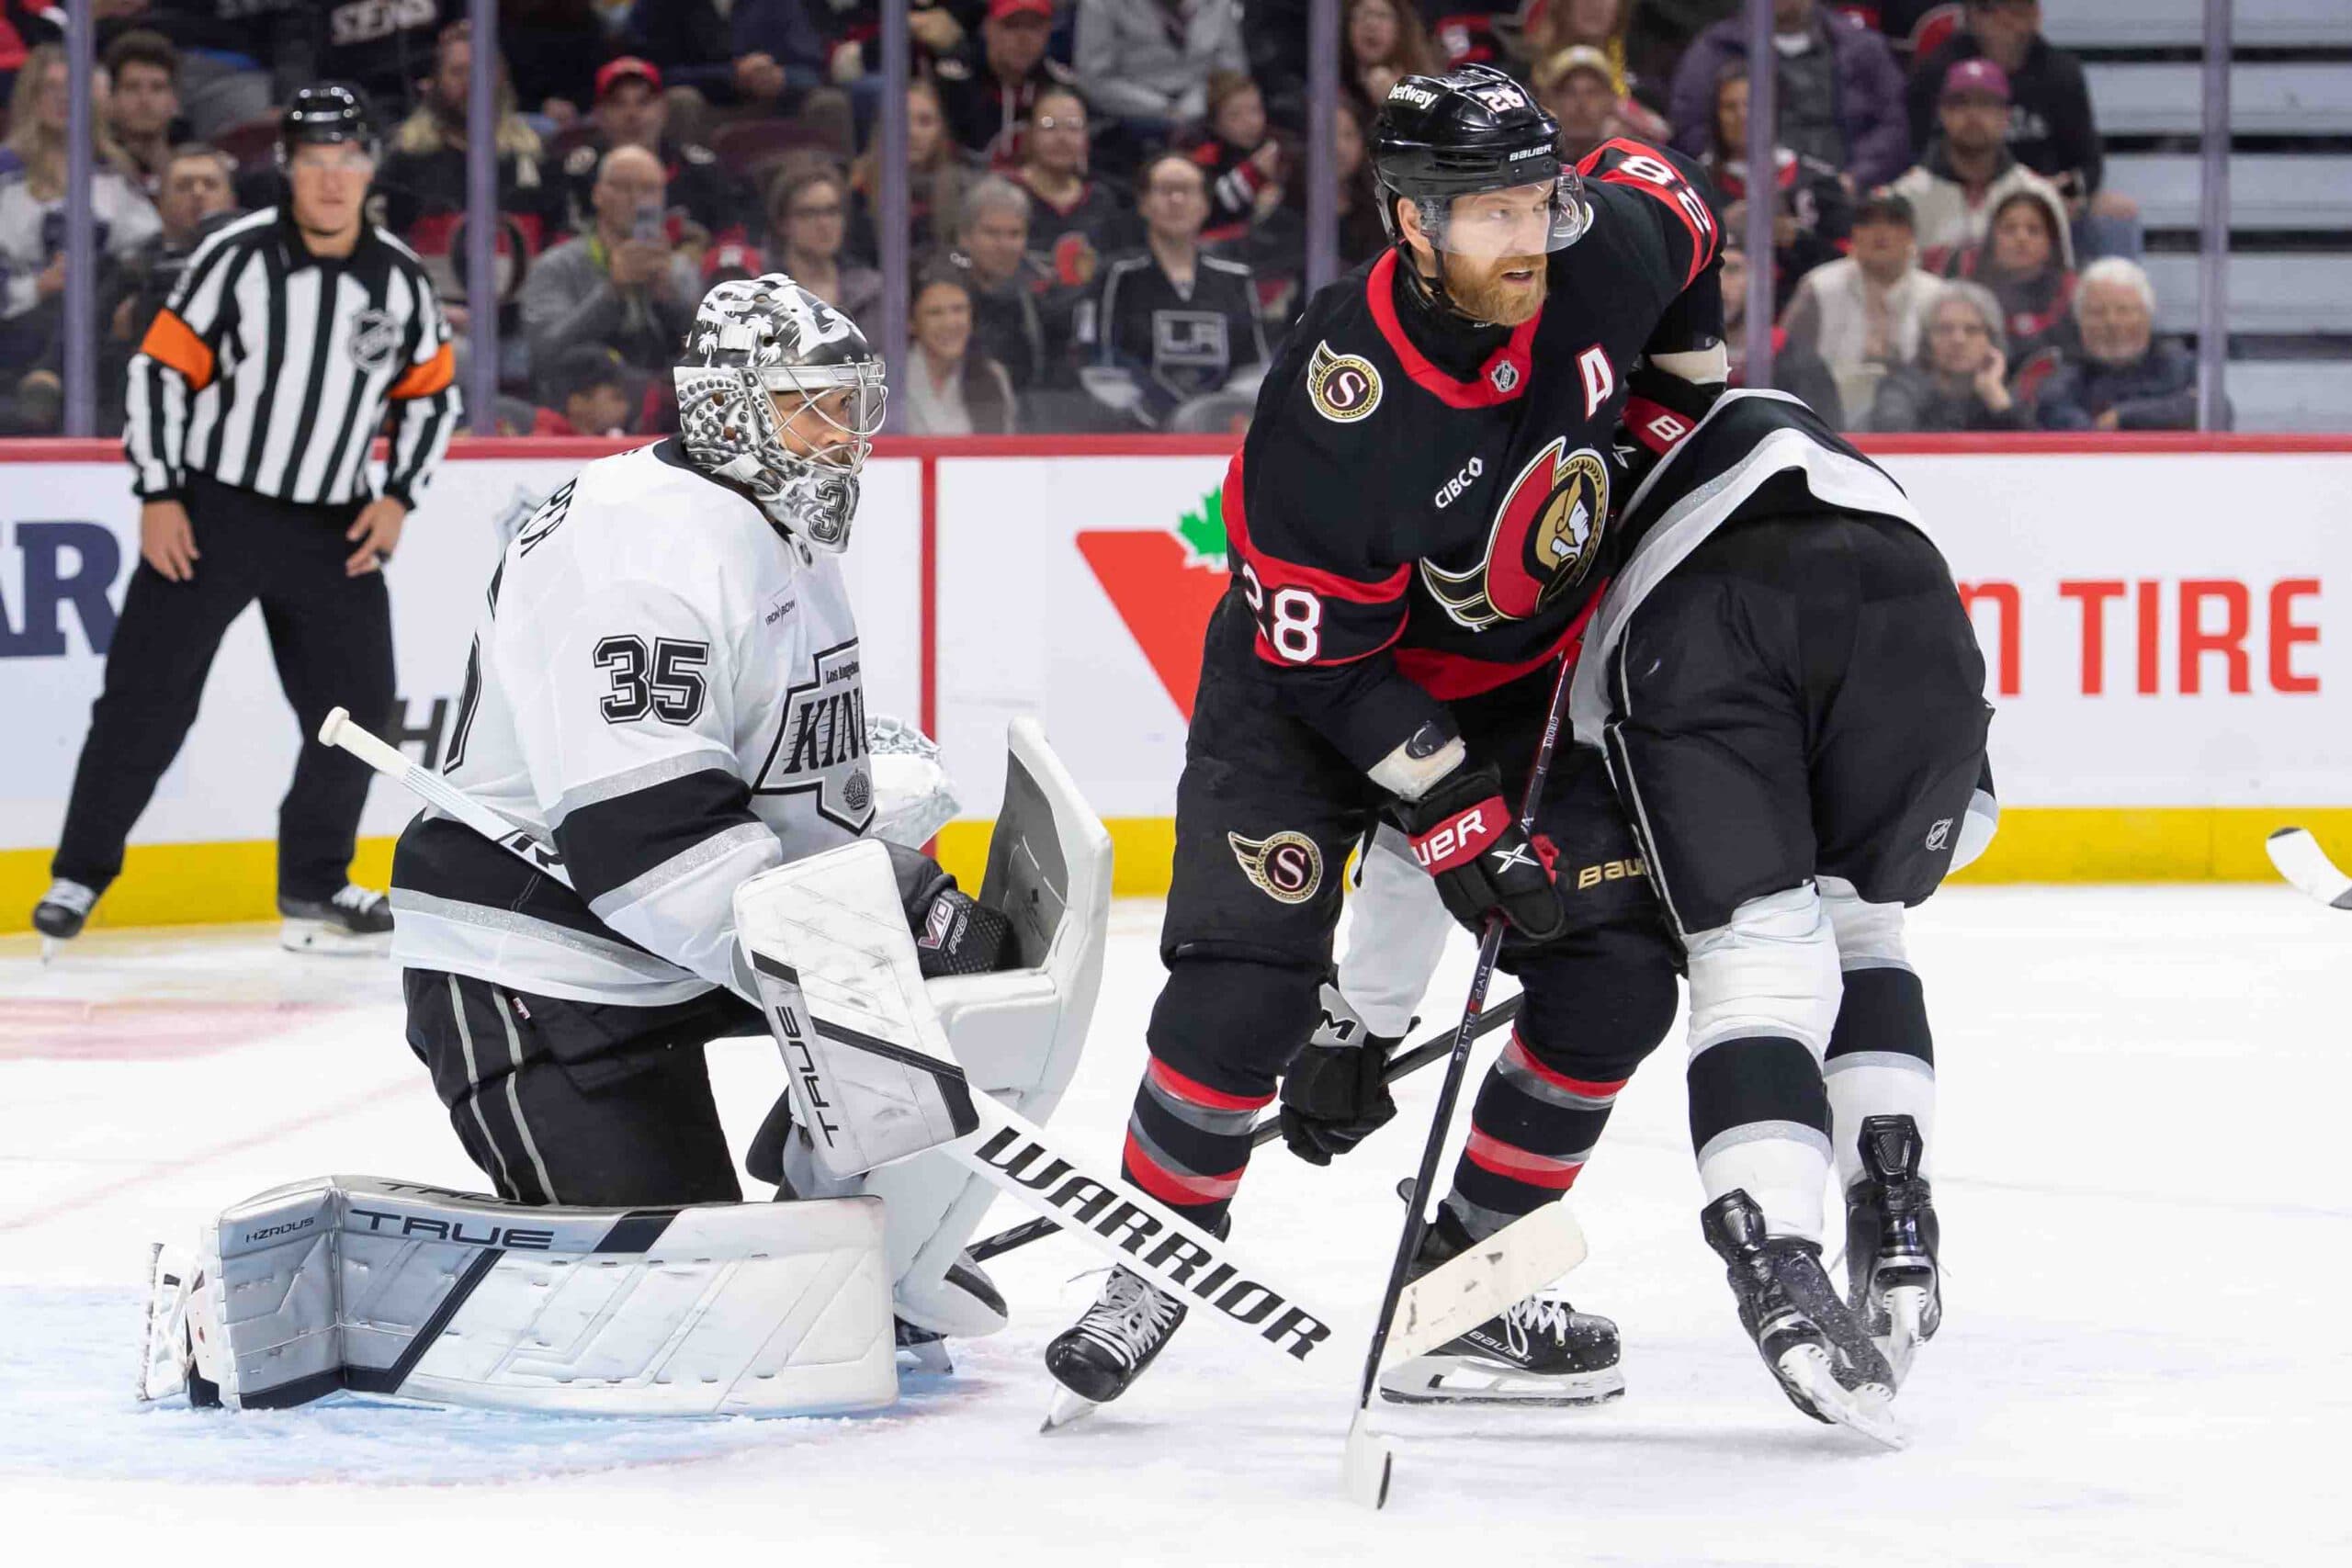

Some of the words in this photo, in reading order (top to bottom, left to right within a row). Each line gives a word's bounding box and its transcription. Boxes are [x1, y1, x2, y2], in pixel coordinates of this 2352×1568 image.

[1387, 84, 1439, 109] betway
[1509, 143, 1553, 162] BAUER
[1577, 344, 1614, 420] A
[0, 523, 120, 656] R
[1243, 563, 1321, 662] 28
[826, 670, 838, 683] Los
[2058, 579, 2319, 695] TIRE
[593, 635, 709, 726] 35
[948, 914, 967, 954] PRO
[775, 1006, 839, 1148] TRUE
[350, 1209, 555, 1250] TRUE
[975, 1126, 1331, 1361] WARRIOR
